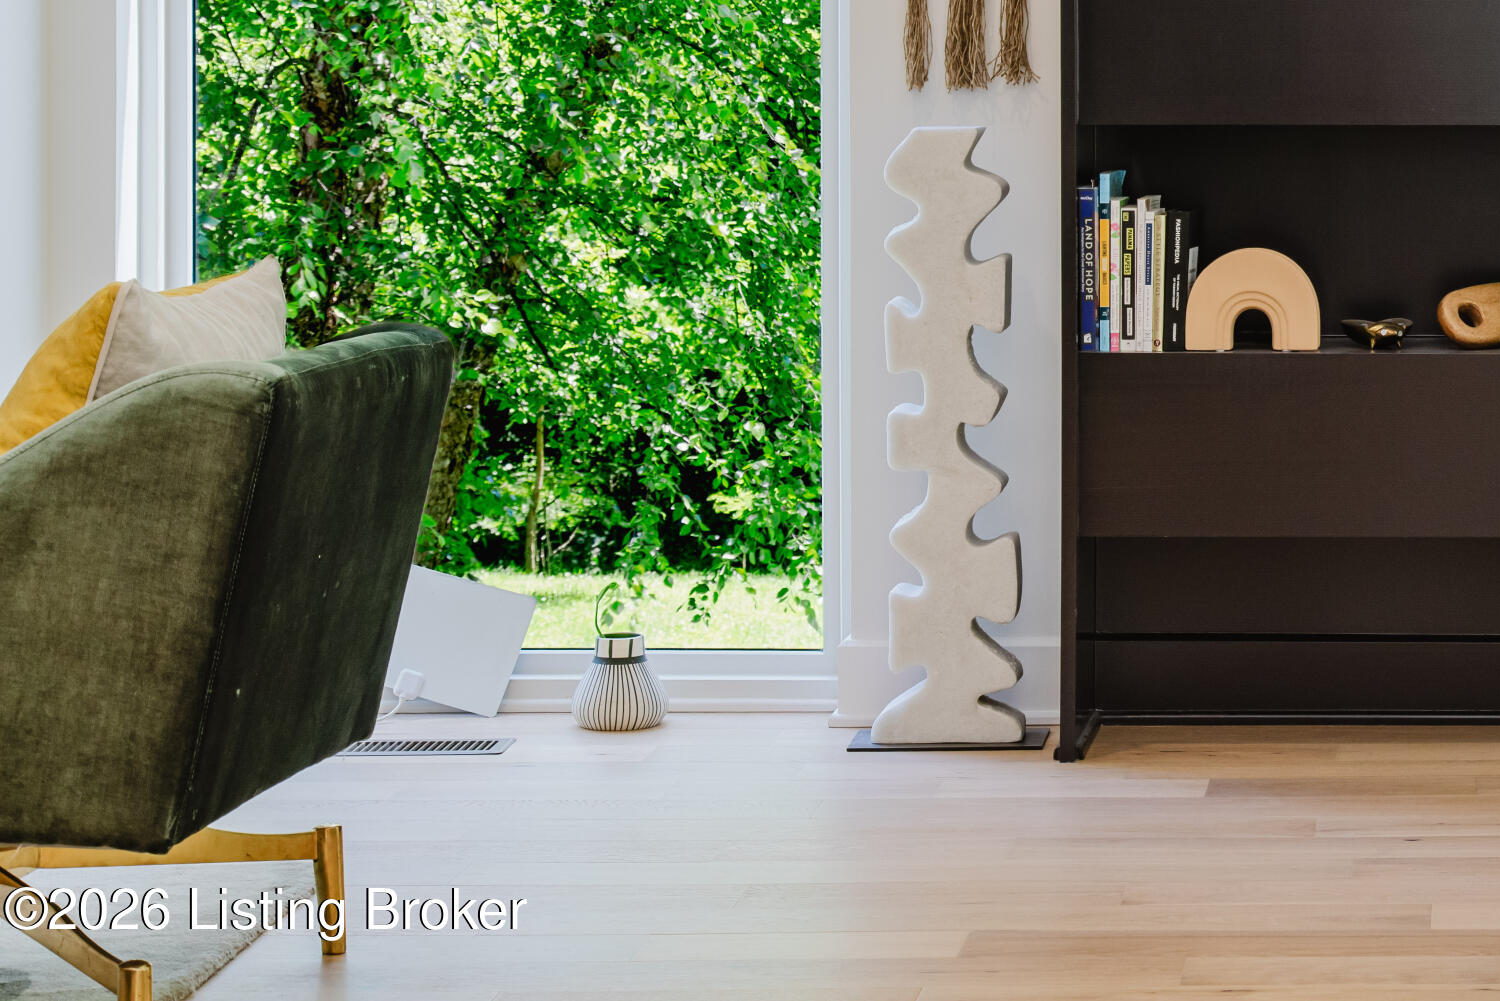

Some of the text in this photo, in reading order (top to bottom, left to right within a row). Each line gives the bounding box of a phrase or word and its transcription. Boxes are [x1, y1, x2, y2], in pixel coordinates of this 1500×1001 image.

[1084, 218, 1094, 301] LAND OF HOPE
[1174, 218, 1182, 264] FASHIONPEDIA
